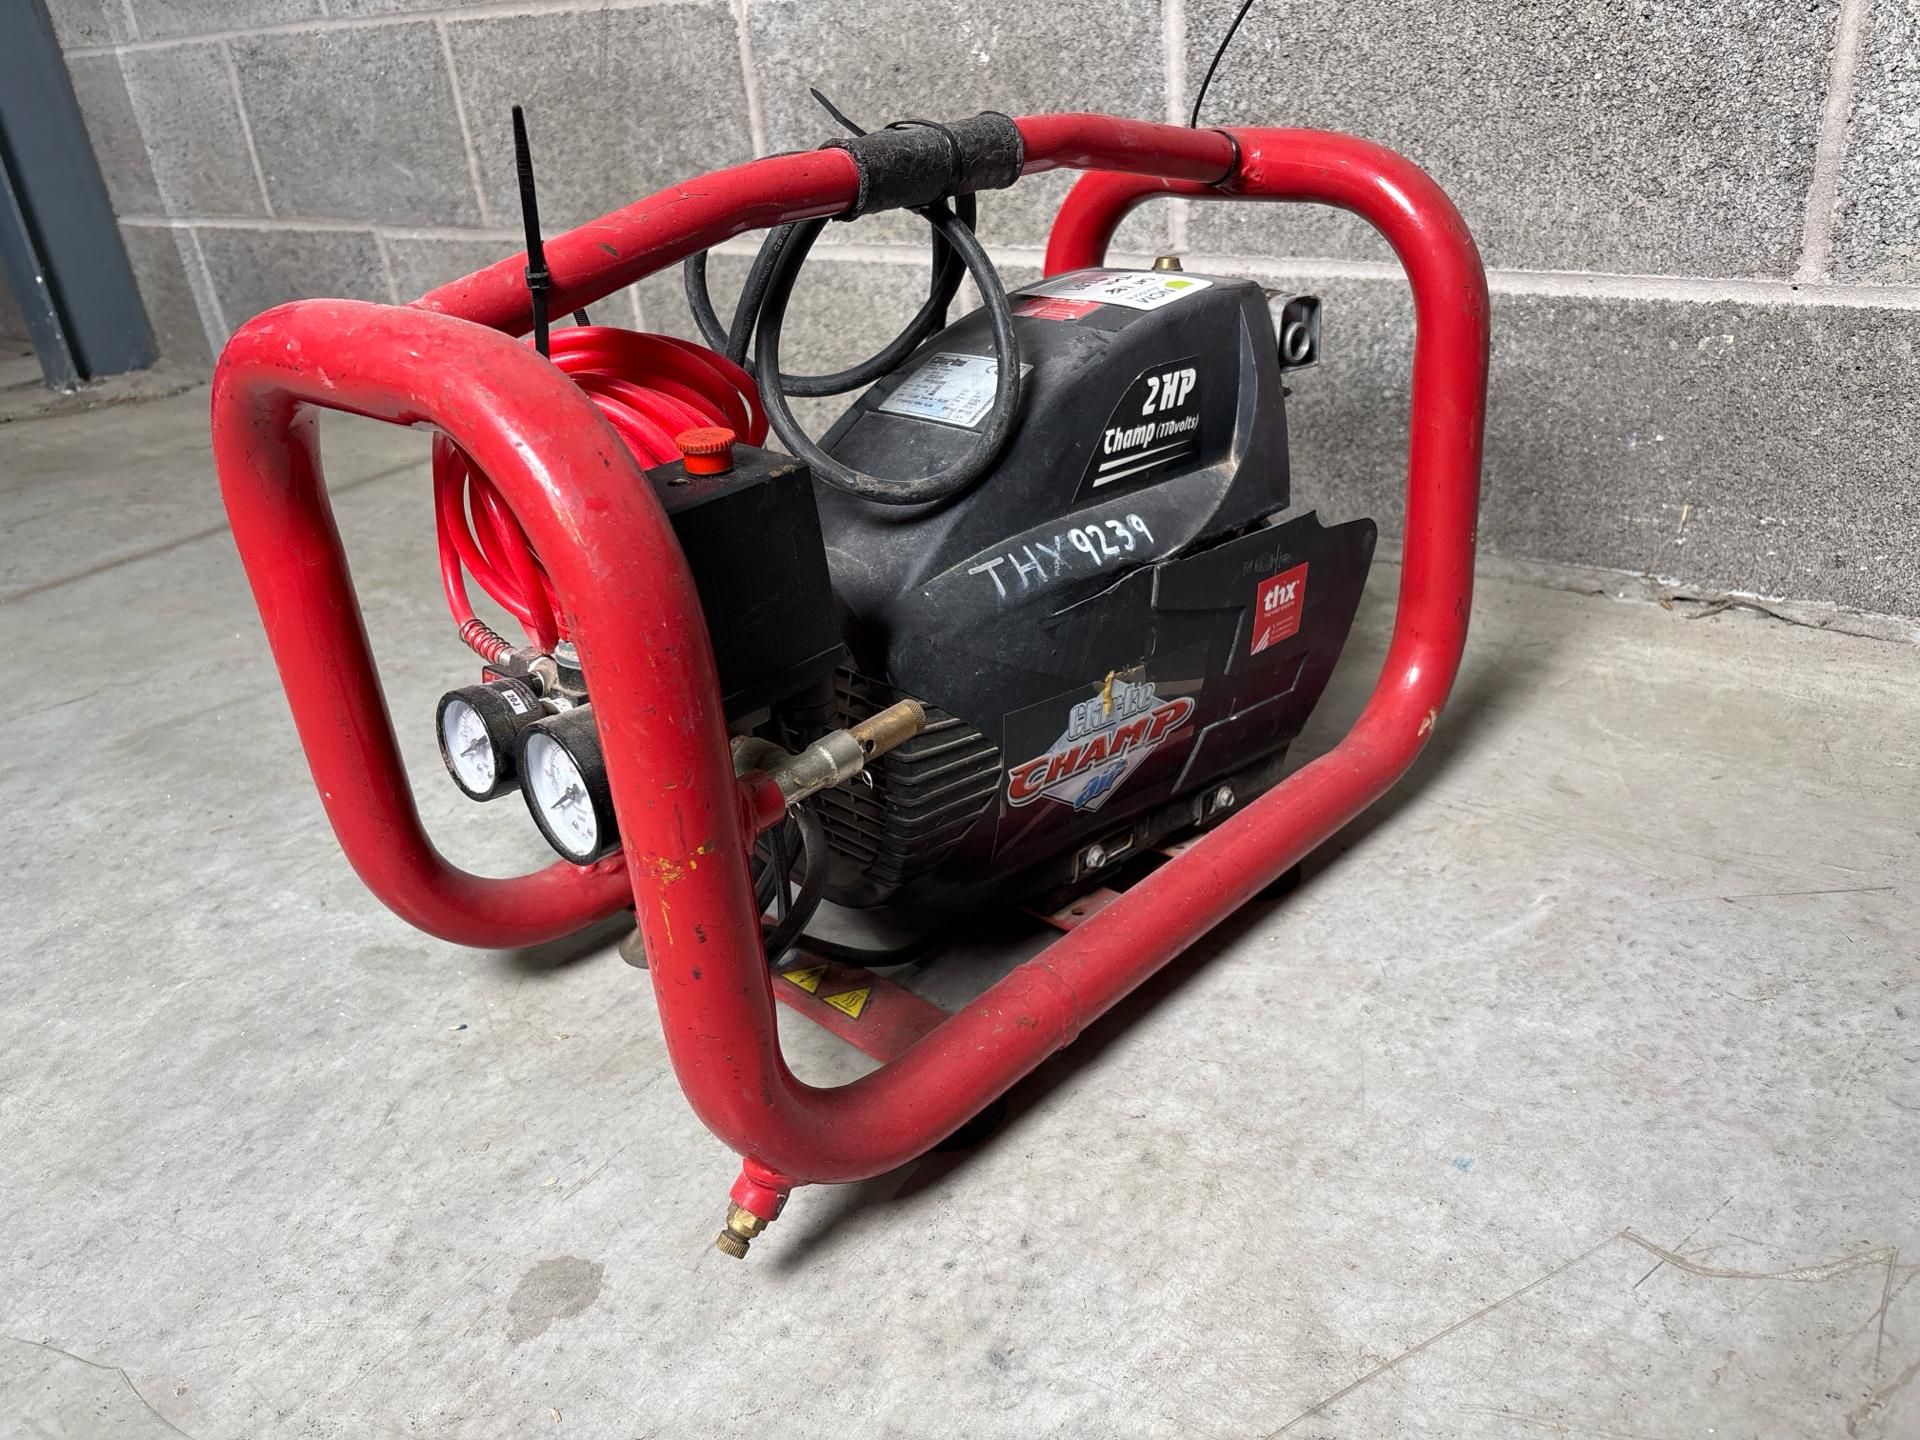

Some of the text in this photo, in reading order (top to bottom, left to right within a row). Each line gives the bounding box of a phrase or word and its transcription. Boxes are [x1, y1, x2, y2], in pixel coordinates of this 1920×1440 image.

[1103, 413, 1199, 455] Champ (110volts)
[1263, 580, 1298, 612] thx
[1008, 697, 1194, 805] CHAMP
[1073, 759, 1128, 809] air
